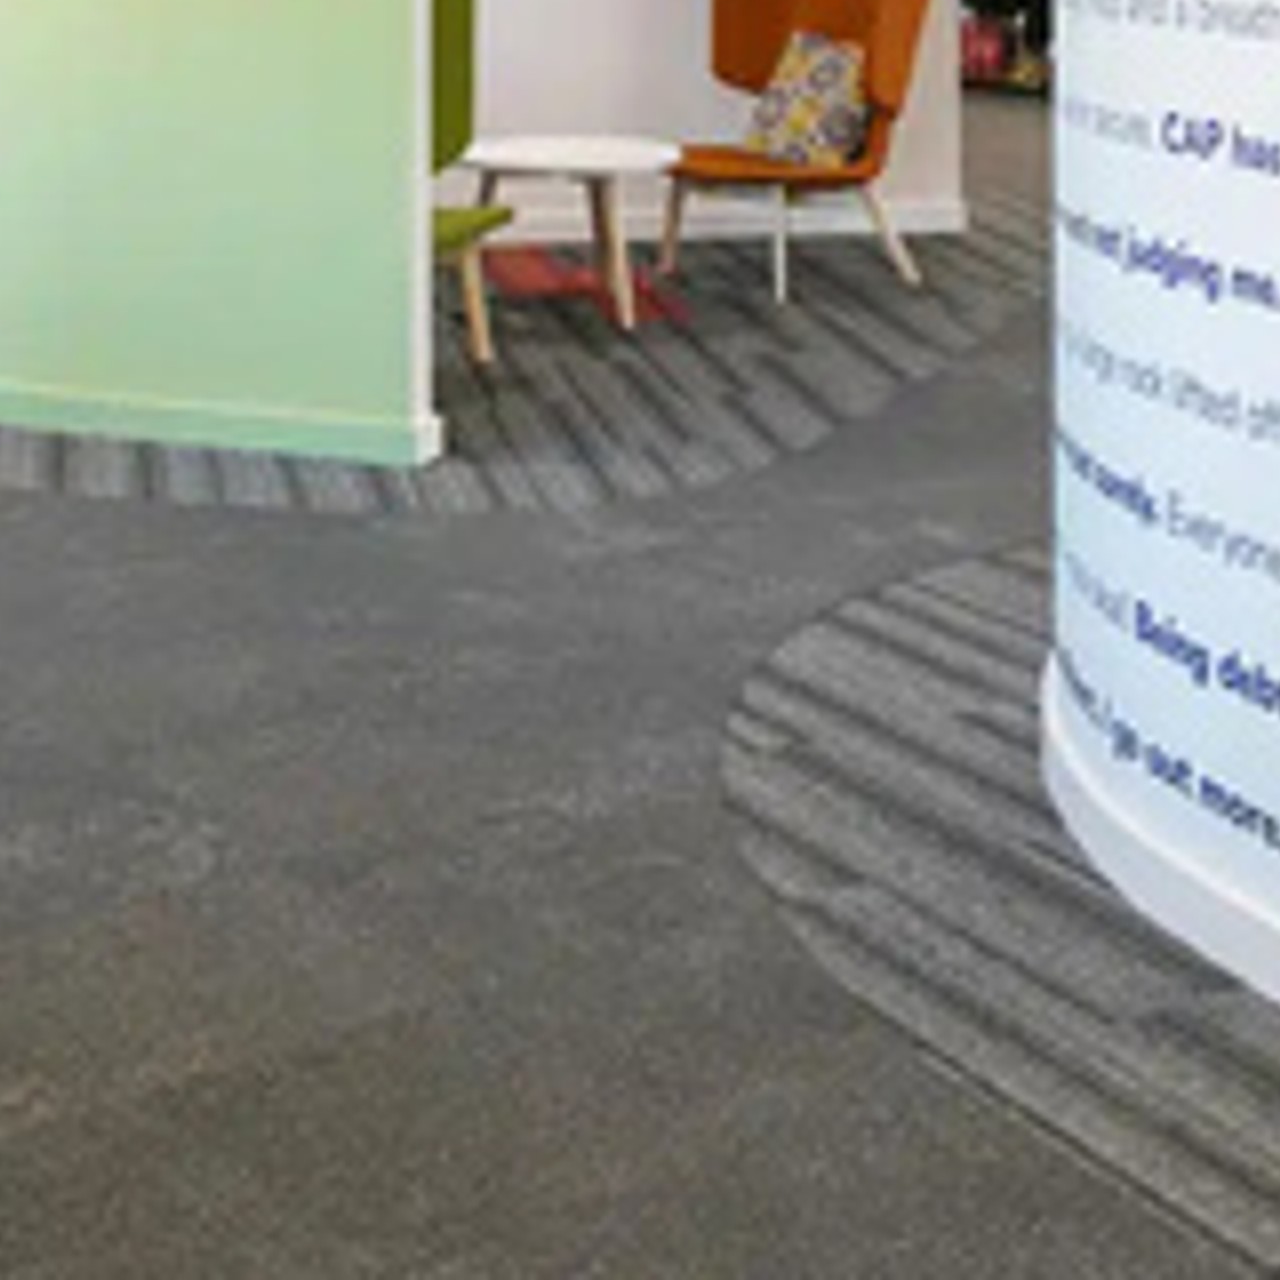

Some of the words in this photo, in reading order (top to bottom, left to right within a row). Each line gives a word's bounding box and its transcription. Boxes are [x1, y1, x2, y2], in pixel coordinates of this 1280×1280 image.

[1161, 109, 1223, 160] CAP
[1121, 223, 1222, 302] judging
[1135, 597, 1210, 688] Being
